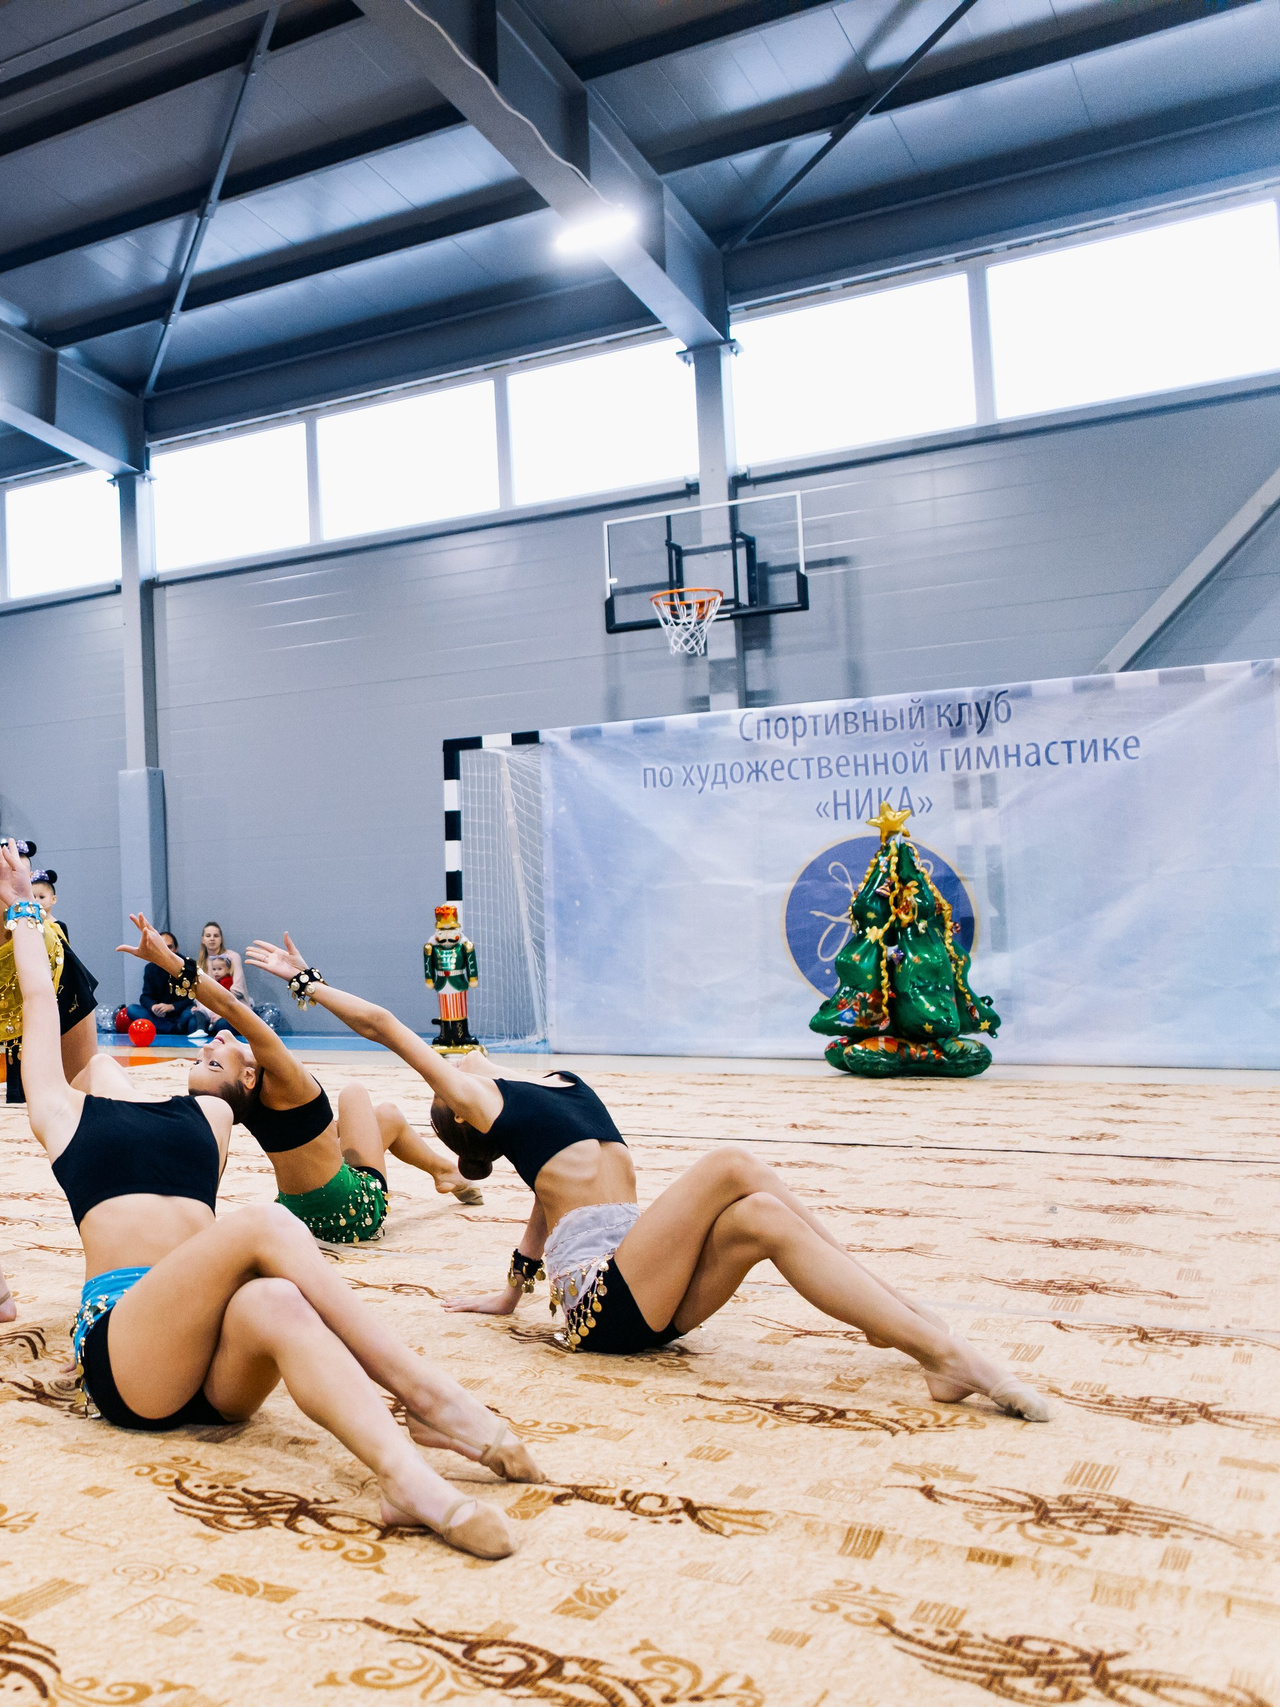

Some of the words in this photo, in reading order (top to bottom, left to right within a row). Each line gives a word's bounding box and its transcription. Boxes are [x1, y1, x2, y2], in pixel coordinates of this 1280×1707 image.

[738, 698, 925, 748] Спортивный
[936, 689, 1012, 735] клуб
[642, 766, 674, 789] по
[681, 741, 929, 794] художественной
[939, 735, 1141, 772] гимнастике
